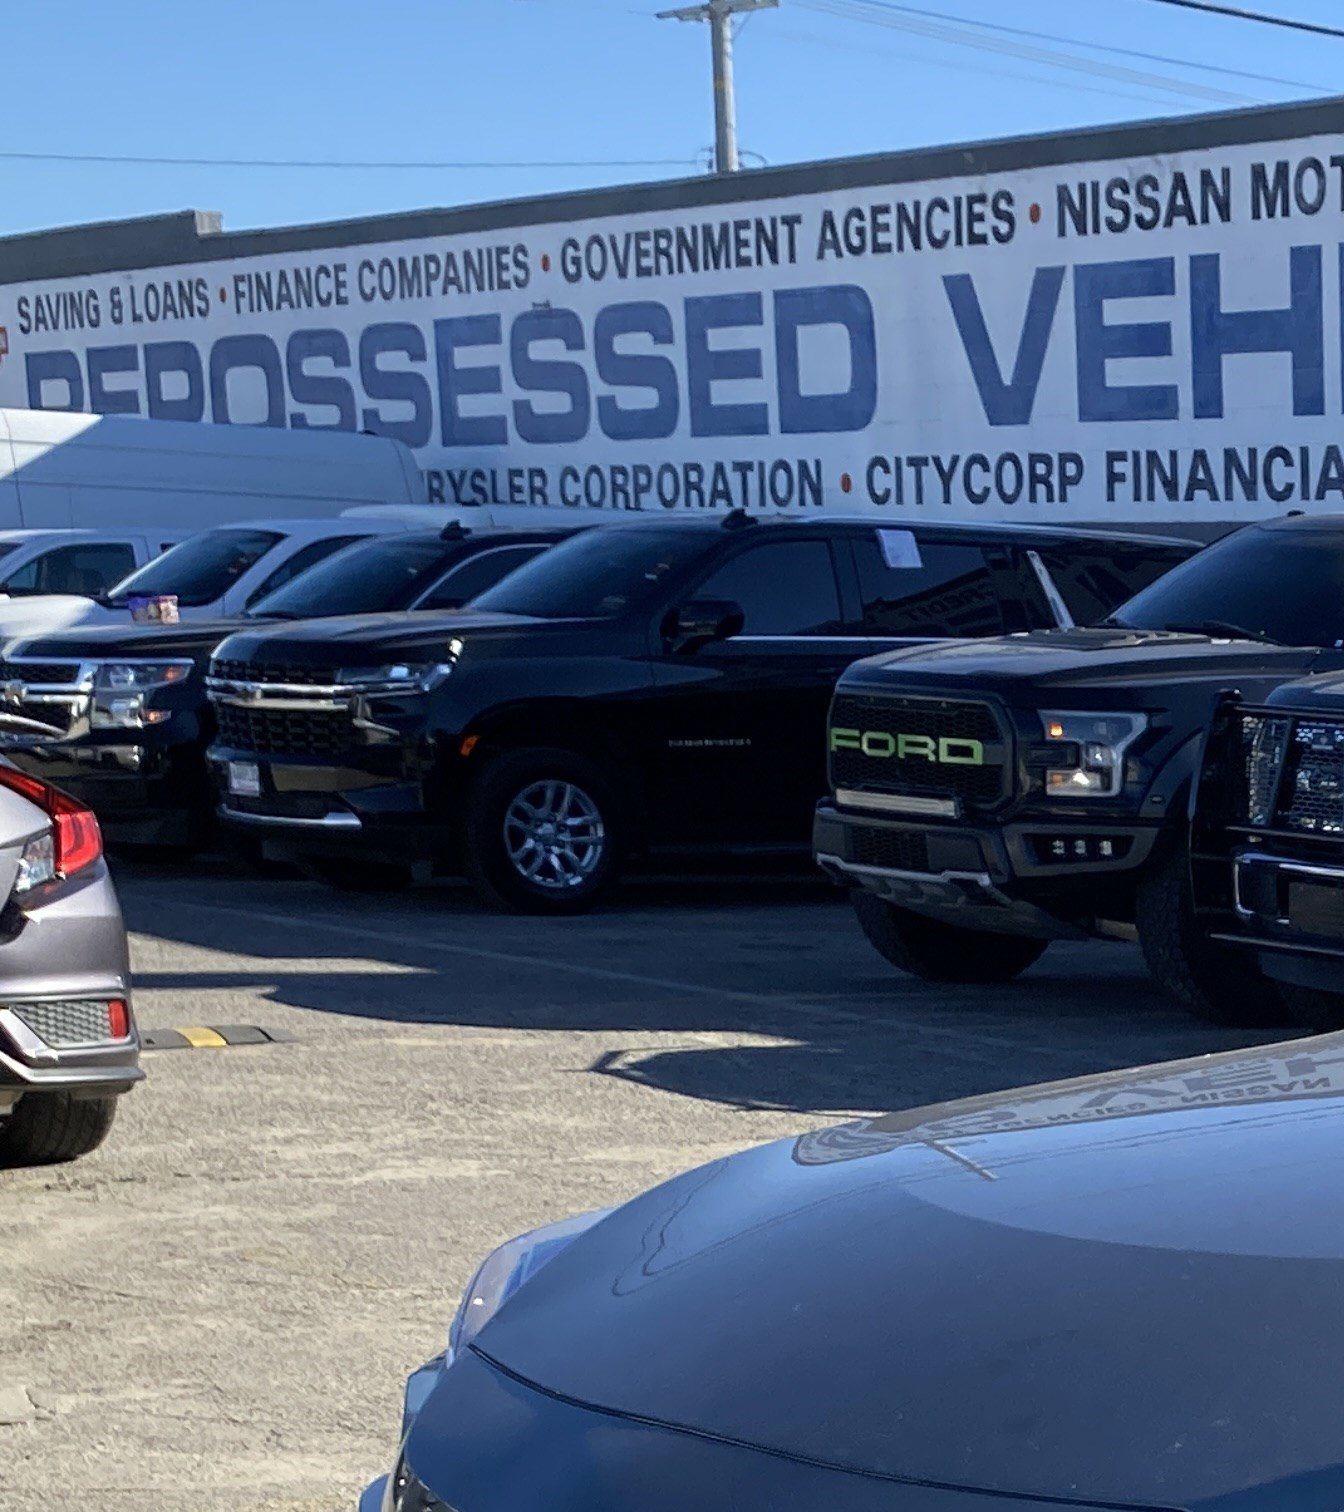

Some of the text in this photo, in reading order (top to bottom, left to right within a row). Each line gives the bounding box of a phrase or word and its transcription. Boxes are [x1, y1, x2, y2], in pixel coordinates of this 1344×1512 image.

[1056, 166, 1233, 237] NISSAN
[561, 188, 1016, 283] GOVERNMENT AGENCIES
[17, 276, 211, 335] SAVING & LOANS
[233, 244, 531, 315] FINANCE COMPANIES
[420, 456, 824, 511] RYSLER CORPORATION
[865, 450, 1085, 508] CITYCORP
[829, 727, 985, 766] FORD
